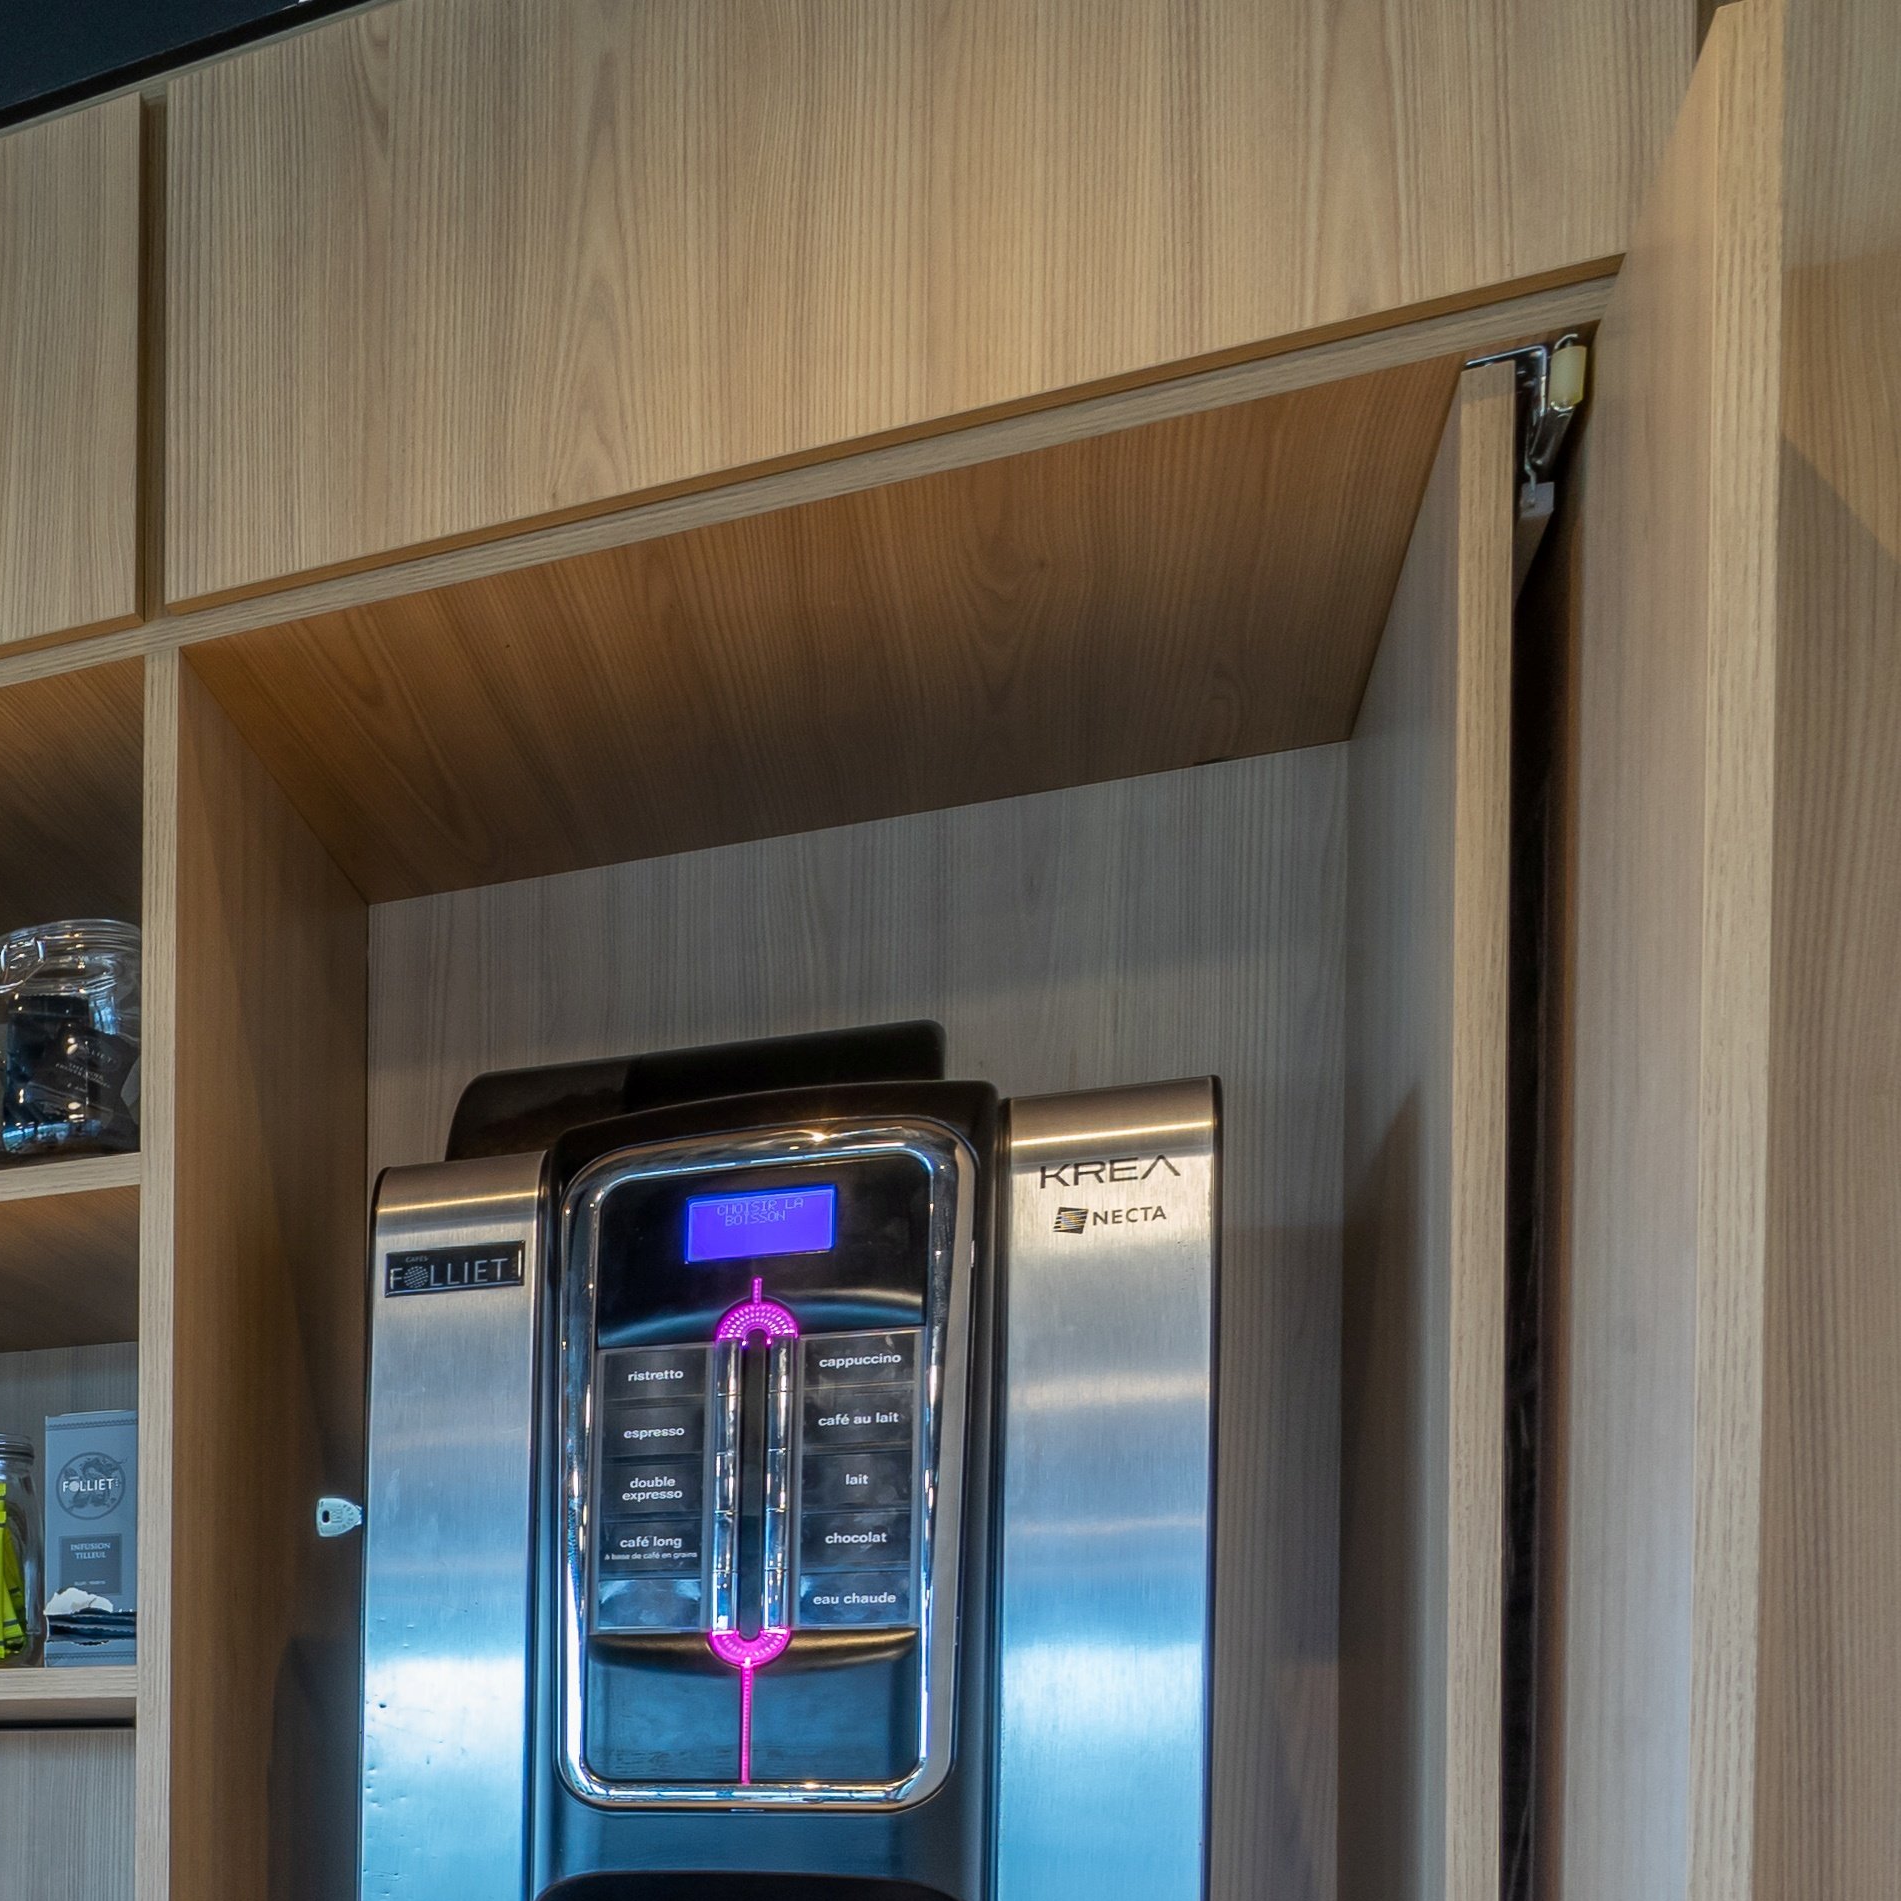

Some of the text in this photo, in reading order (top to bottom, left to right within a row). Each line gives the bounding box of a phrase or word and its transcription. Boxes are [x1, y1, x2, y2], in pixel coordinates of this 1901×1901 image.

[1040, 1154, 1181, 1189] KREA
[717, 1197, 804, 1217] CHOISIR LA
[725, 1210, 786, 1227] BOISSON
[1093, 1206, 1167, 1226] NECTA
[390, 1258, 509, 1290] FOLLIET
[819, 1353, 902, 1369] cappuccino
[627, 1369, 684, 1382] ristretto
[818, 1412, 899, 1426] café au lait
[623, 1427, 685, 1440] espresso
[62, 1477, 115, 1493] FOLLIET
[629, 1476, 676, 1488] double
[845, 1473, 868, 1485] lait
[622, 1490, 683, 1502] expresso
[619, 1536, 682, 1549] café long
[825, 1532, 887, 1544] chocolat
[70, 1543, 111, 1551] INFUSION
[75, 1551, 107, 1560] TILLEUL
[631, 1552, 642, 1560] de
[643, 1551, 660, 1559] café
[673, 1551, 697, 1559] grains
[813, 1592, 896, 1605] eau chaude
